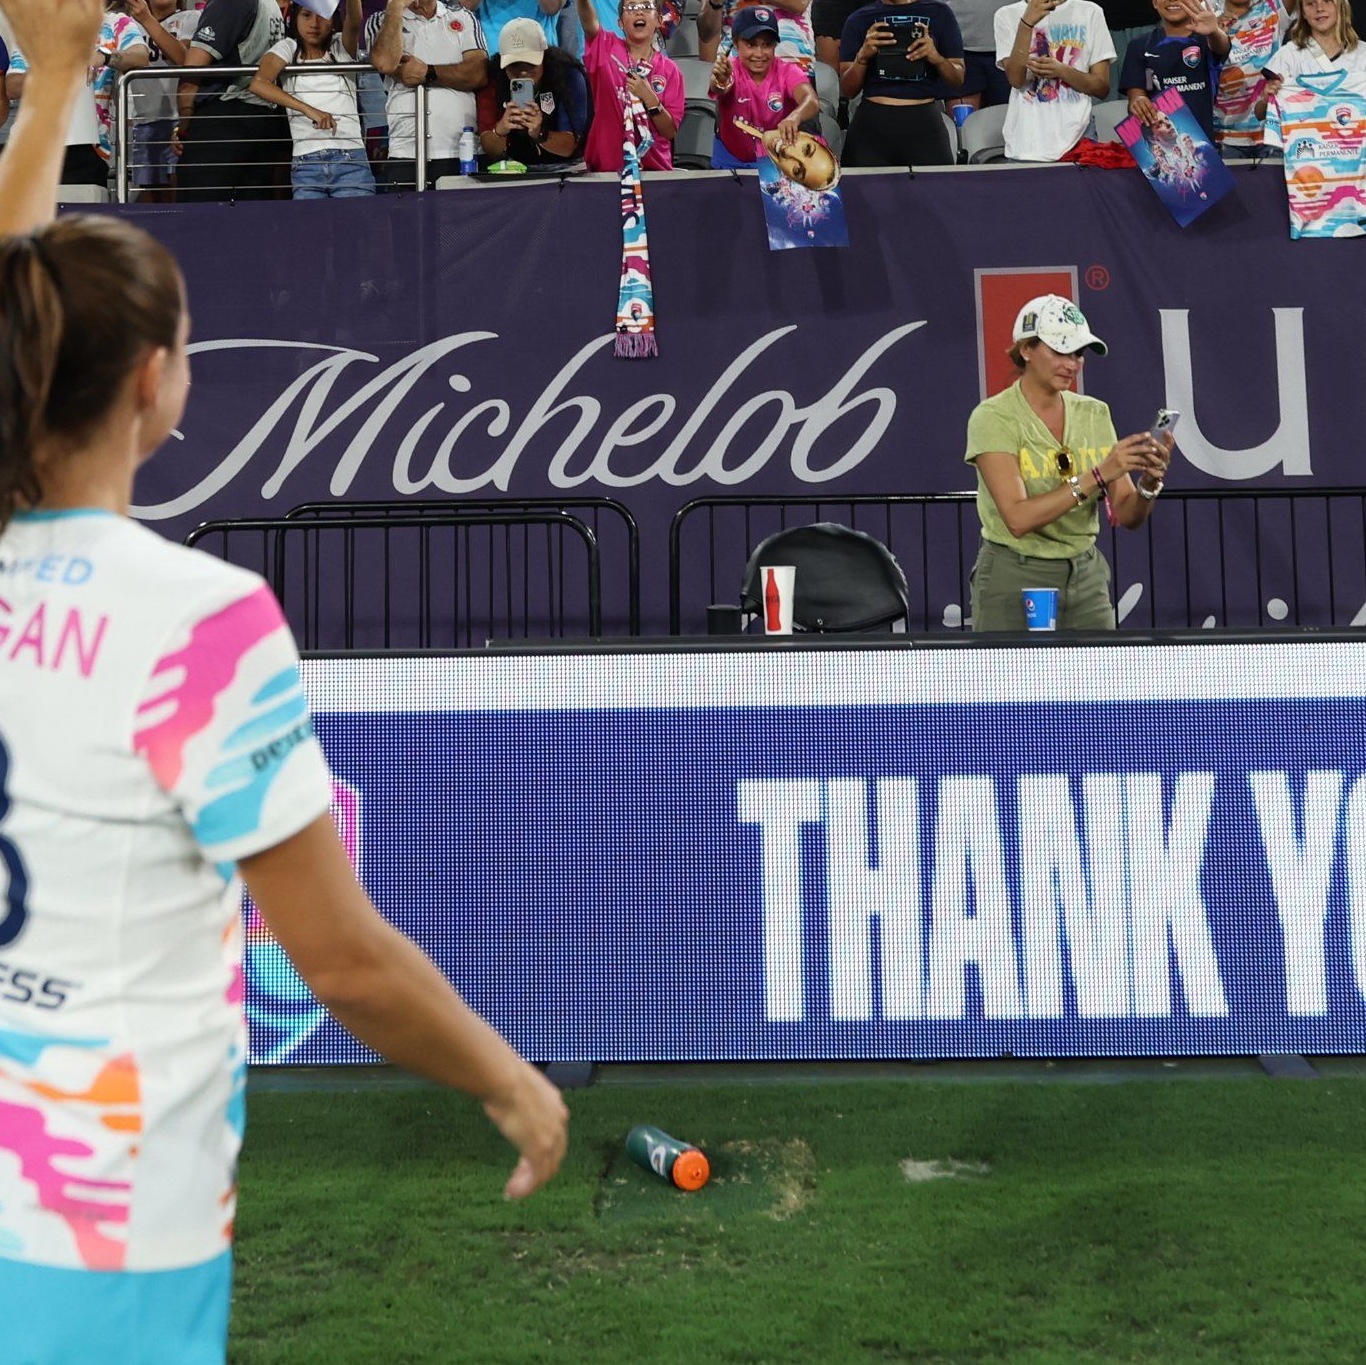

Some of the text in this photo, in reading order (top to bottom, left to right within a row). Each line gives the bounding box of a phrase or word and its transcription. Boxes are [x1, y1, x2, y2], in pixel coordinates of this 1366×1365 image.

[1163, 76, 1188, 85] KAISER
[128, 318, 929, 522] Michelob
[737, 771, 1230, 1023] THANK
